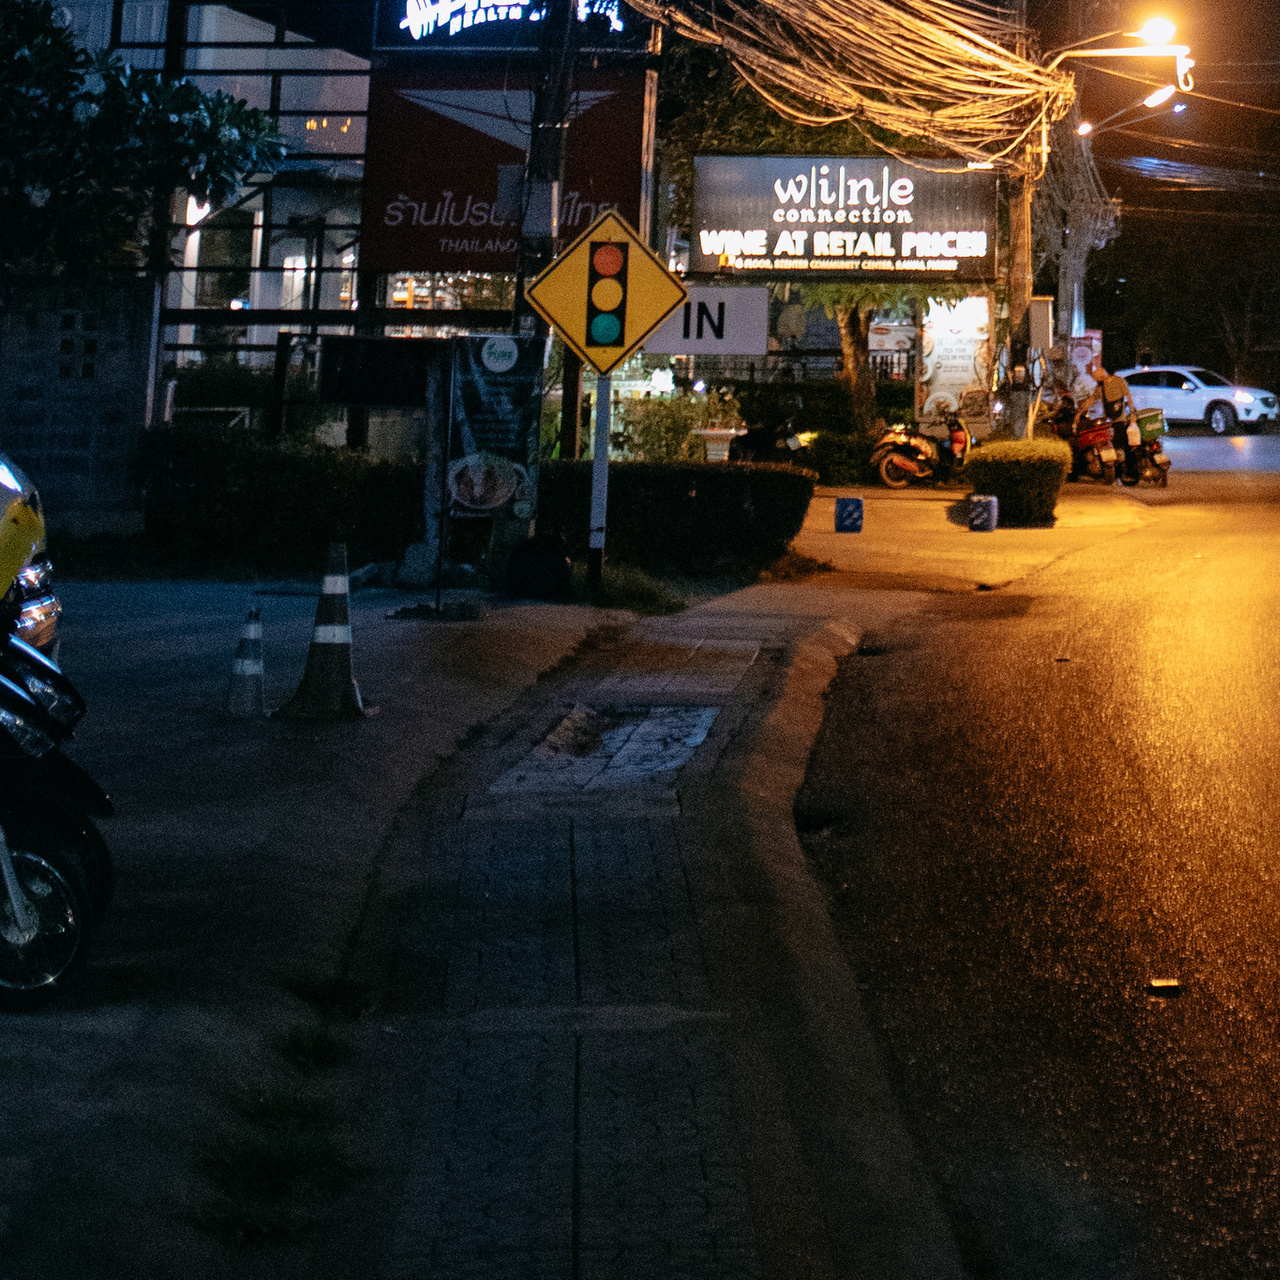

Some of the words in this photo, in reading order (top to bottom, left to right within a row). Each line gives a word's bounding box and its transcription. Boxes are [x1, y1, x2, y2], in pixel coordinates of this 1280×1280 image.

[449, 6, 522, 36] HEALTH
[772, 206, 914, 224] connection
[439, 238, 518, 252] THAILAND
[699, 229, 768, 257] WINE
[772, 230, 808, 256] AT
[813, 231, 896, 257] RETAIL
[809, 259, 861, 270] COMMUNITY
[683, 301, 725, 339] IN
